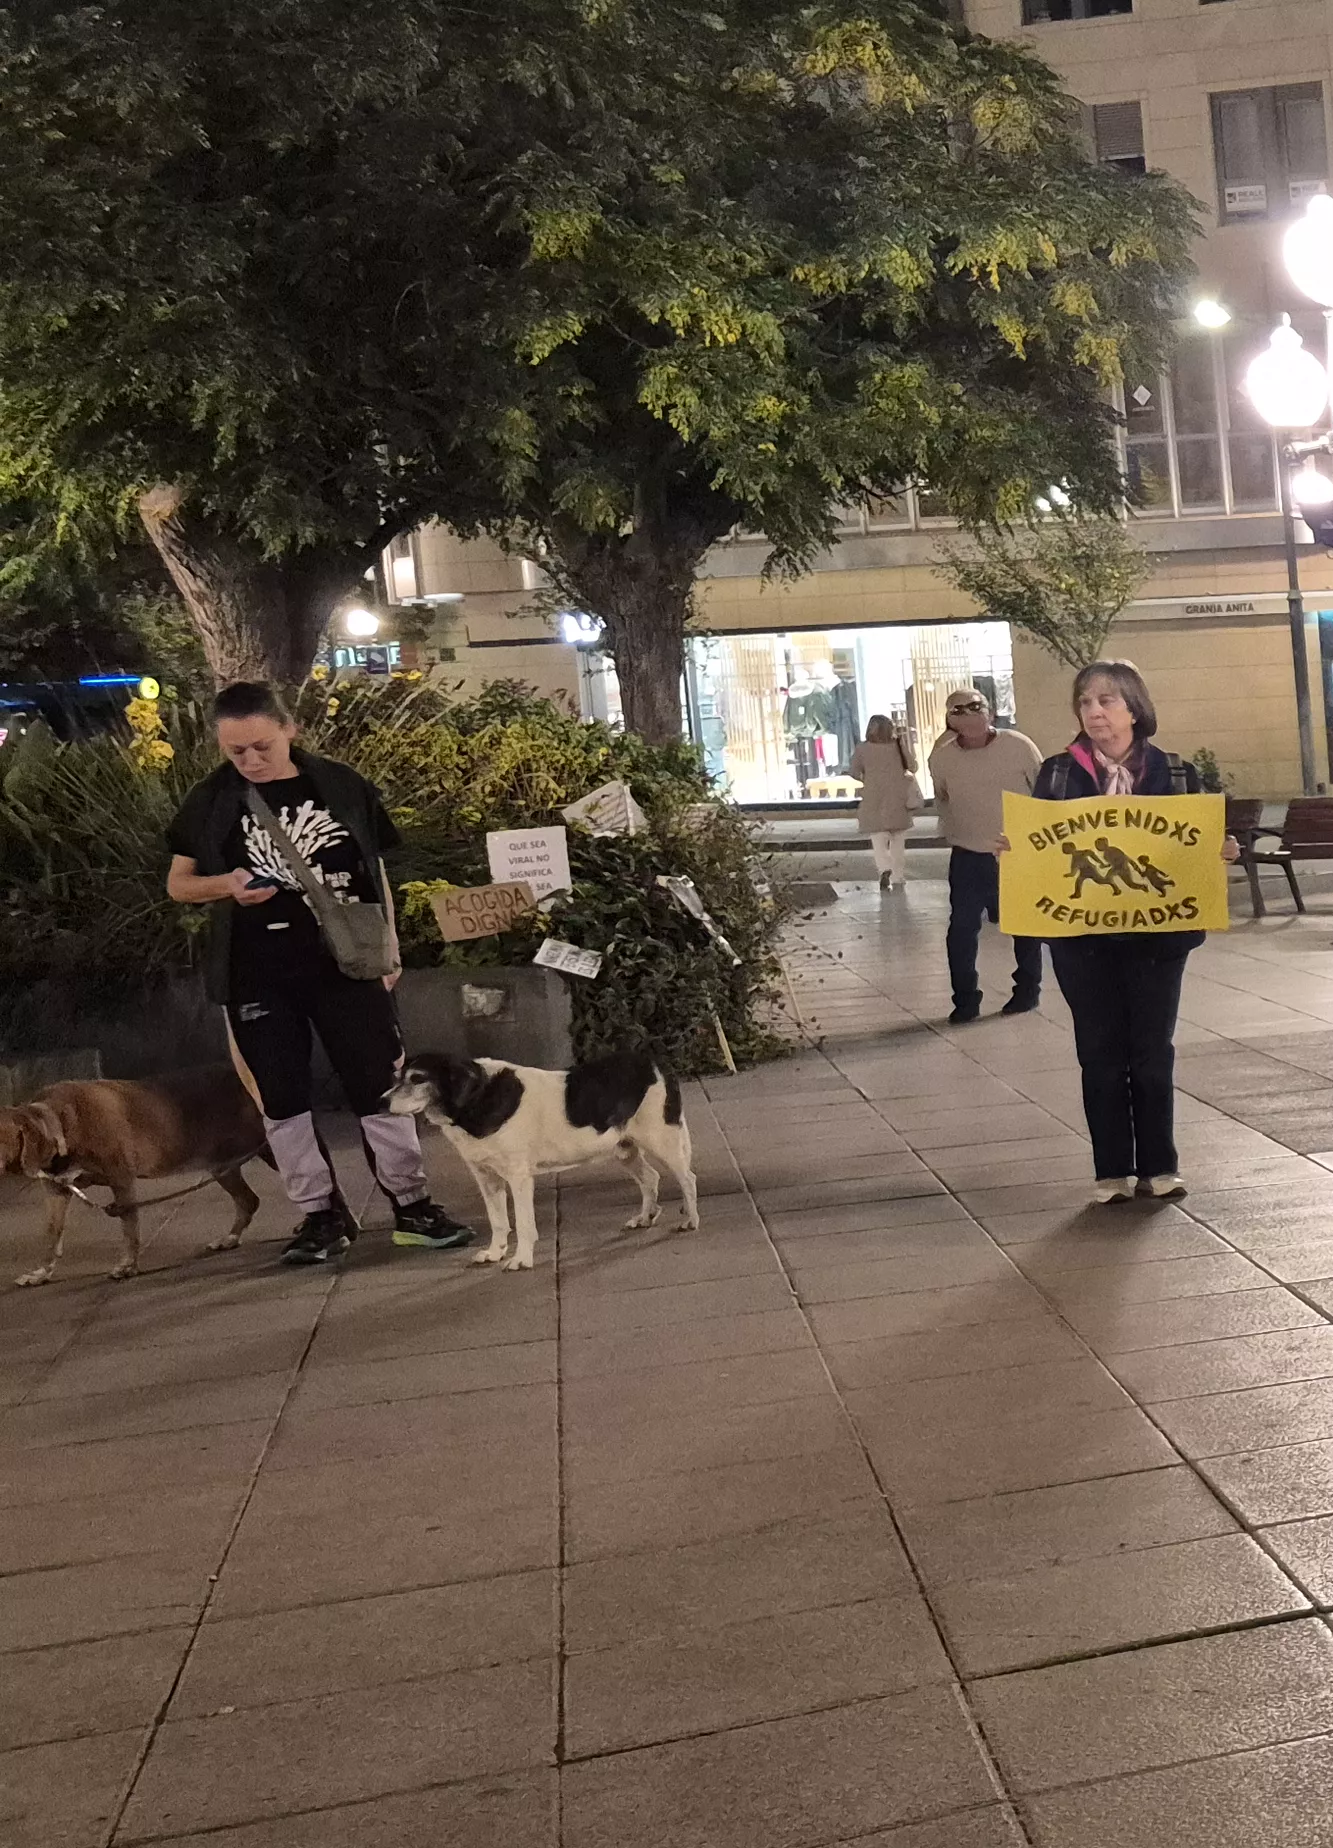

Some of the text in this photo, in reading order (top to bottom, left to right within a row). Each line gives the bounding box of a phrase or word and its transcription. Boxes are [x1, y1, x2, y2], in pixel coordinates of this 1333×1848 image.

[1185, 602, 1255, 615] GRANJA ANITA
[1028, 808, 1202, 852] BIENVENIDXS
[509, 840, 547, 851] QUE SEA
[508, 854, 550, 865] VIRAL NO
[509, 868, 553, 879] SIGNIFICA
[536, 882, 553, 891] SEA
[445, 887, 529, 915] ACOGIDA
[1035, 895, 1200, 928] REFUGIADXS
